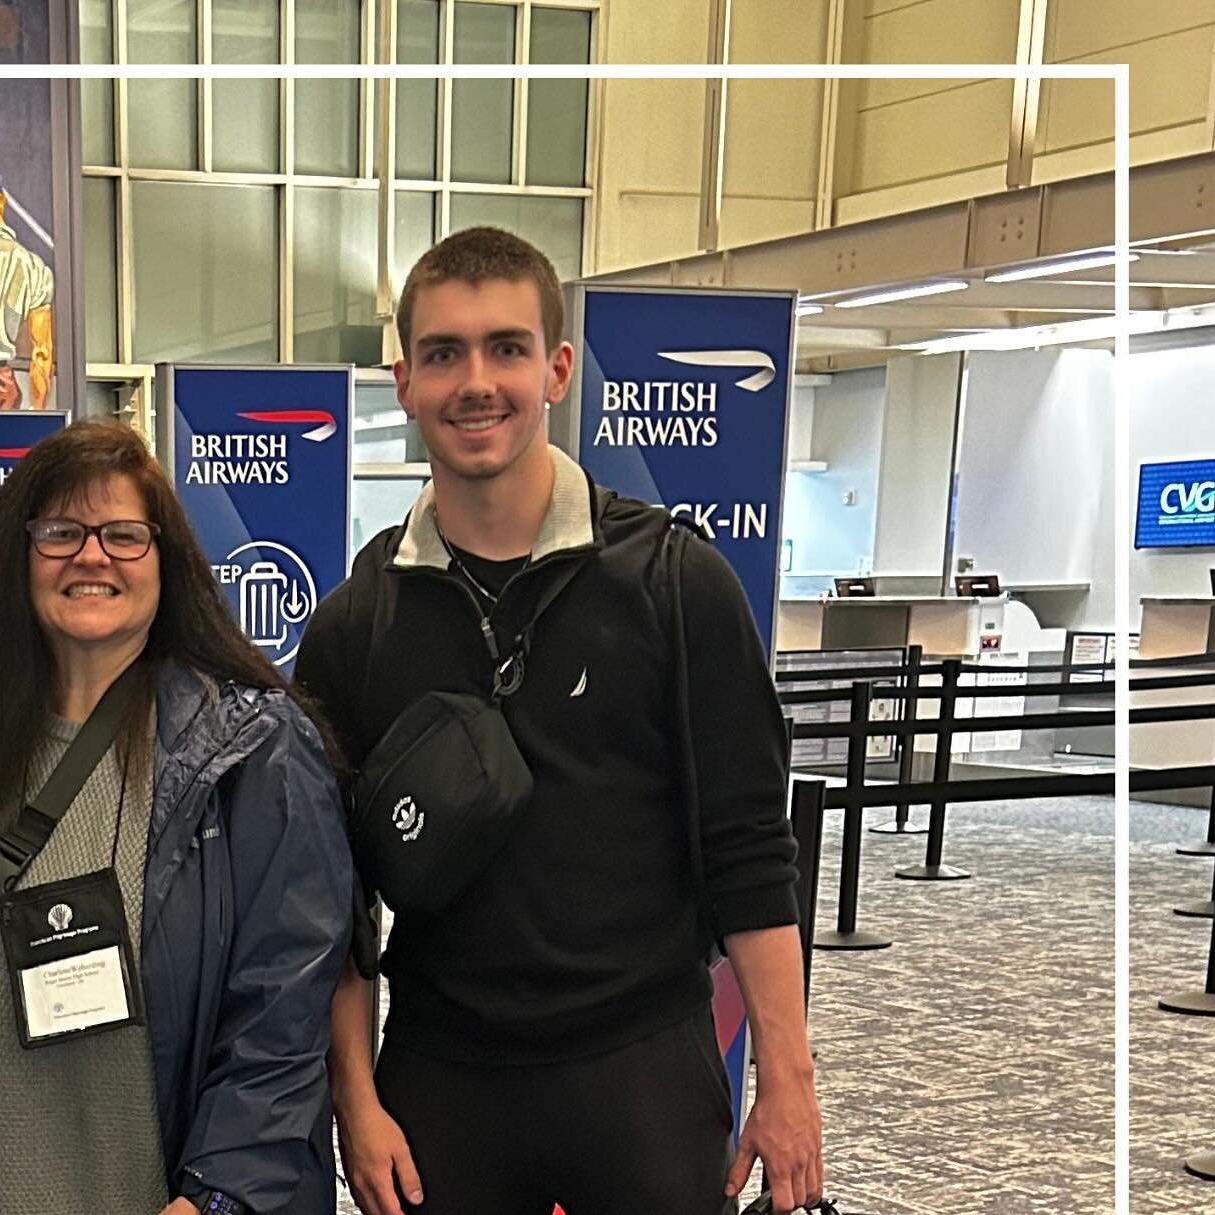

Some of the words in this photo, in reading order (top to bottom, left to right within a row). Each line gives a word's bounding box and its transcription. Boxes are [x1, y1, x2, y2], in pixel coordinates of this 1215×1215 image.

[602, 381, 717, 412] BRITISH
[191, 434, 286, 458] BRITISH
[593, 416, 718, 446] AIRWAYS
[185, 461, 289, 484] AIRWAYS
[1160, 481, 1215, 514] CVG
